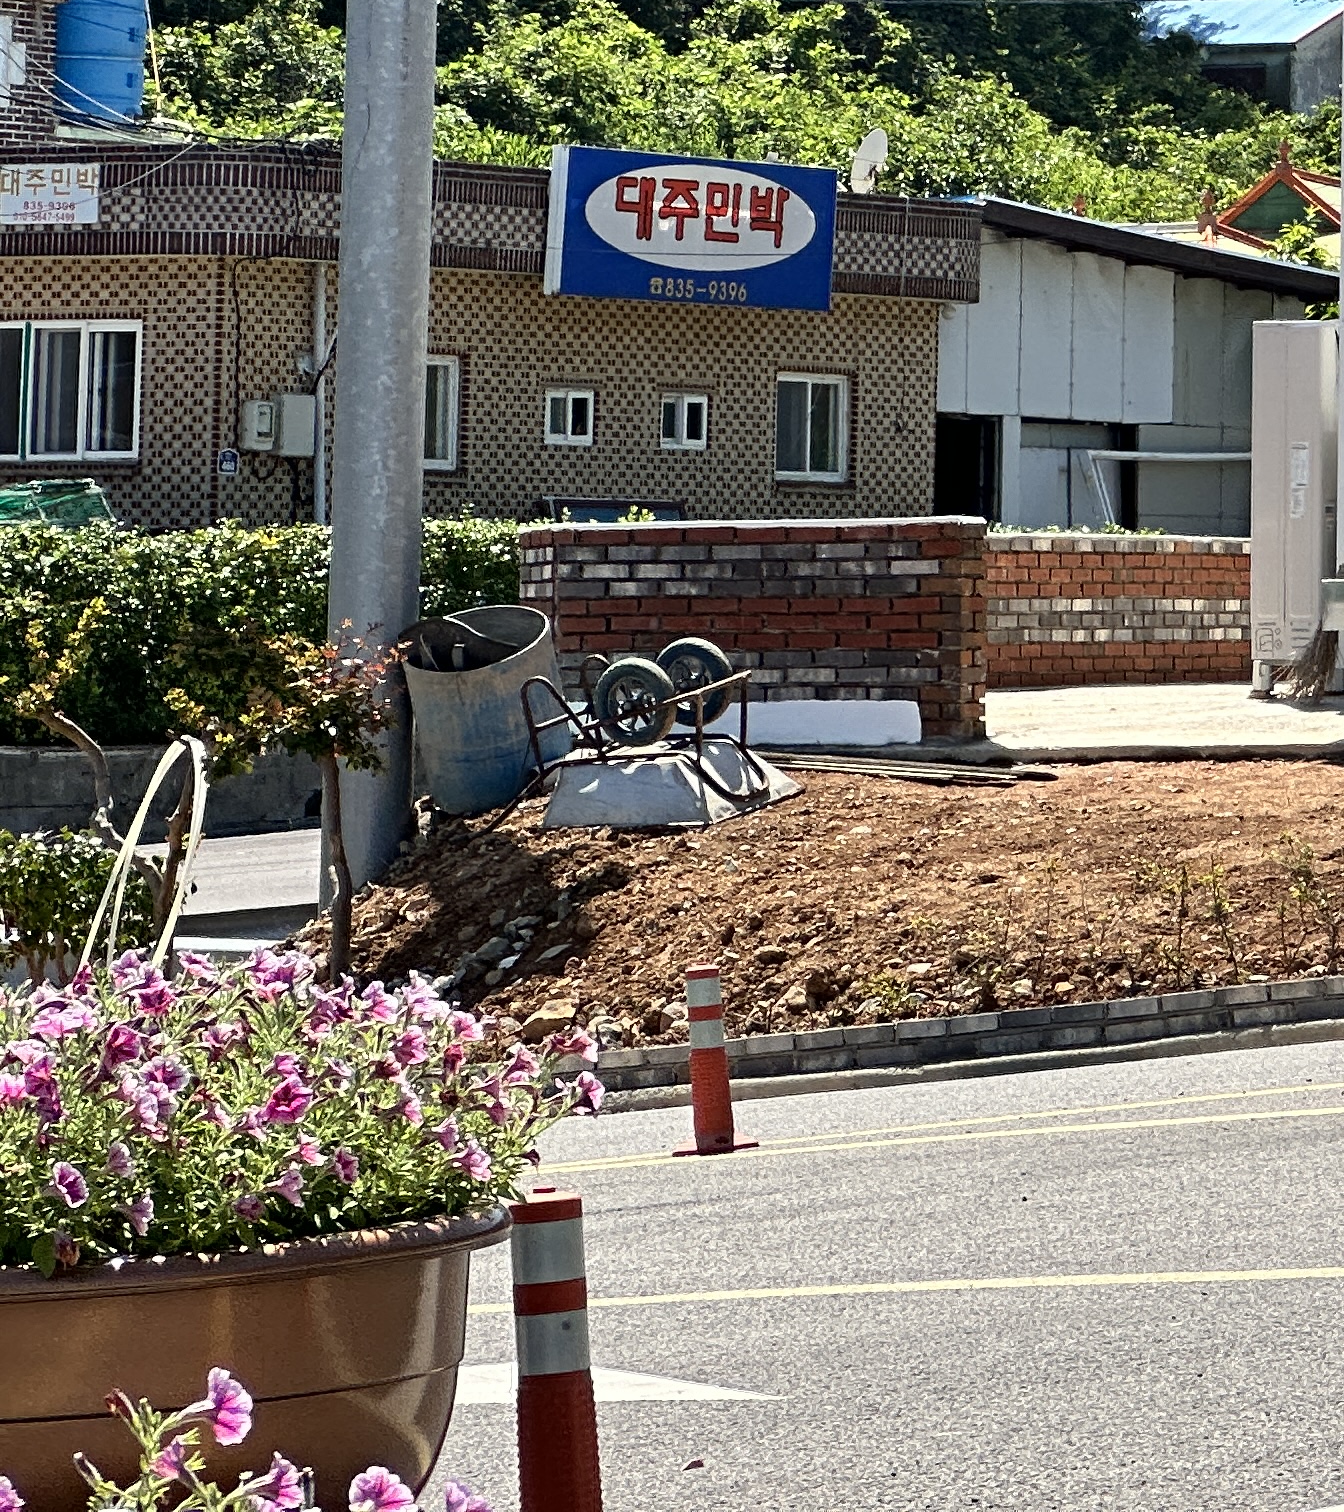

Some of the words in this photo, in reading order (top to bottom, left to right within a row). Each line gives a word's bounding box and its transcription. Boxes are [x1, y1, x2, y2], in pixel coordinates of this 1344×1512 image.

[0, 167, 98, 196] 대주민박
[615, 176, 790, 248] 대주민박
[665, 277, 747, 302] 835-9396
